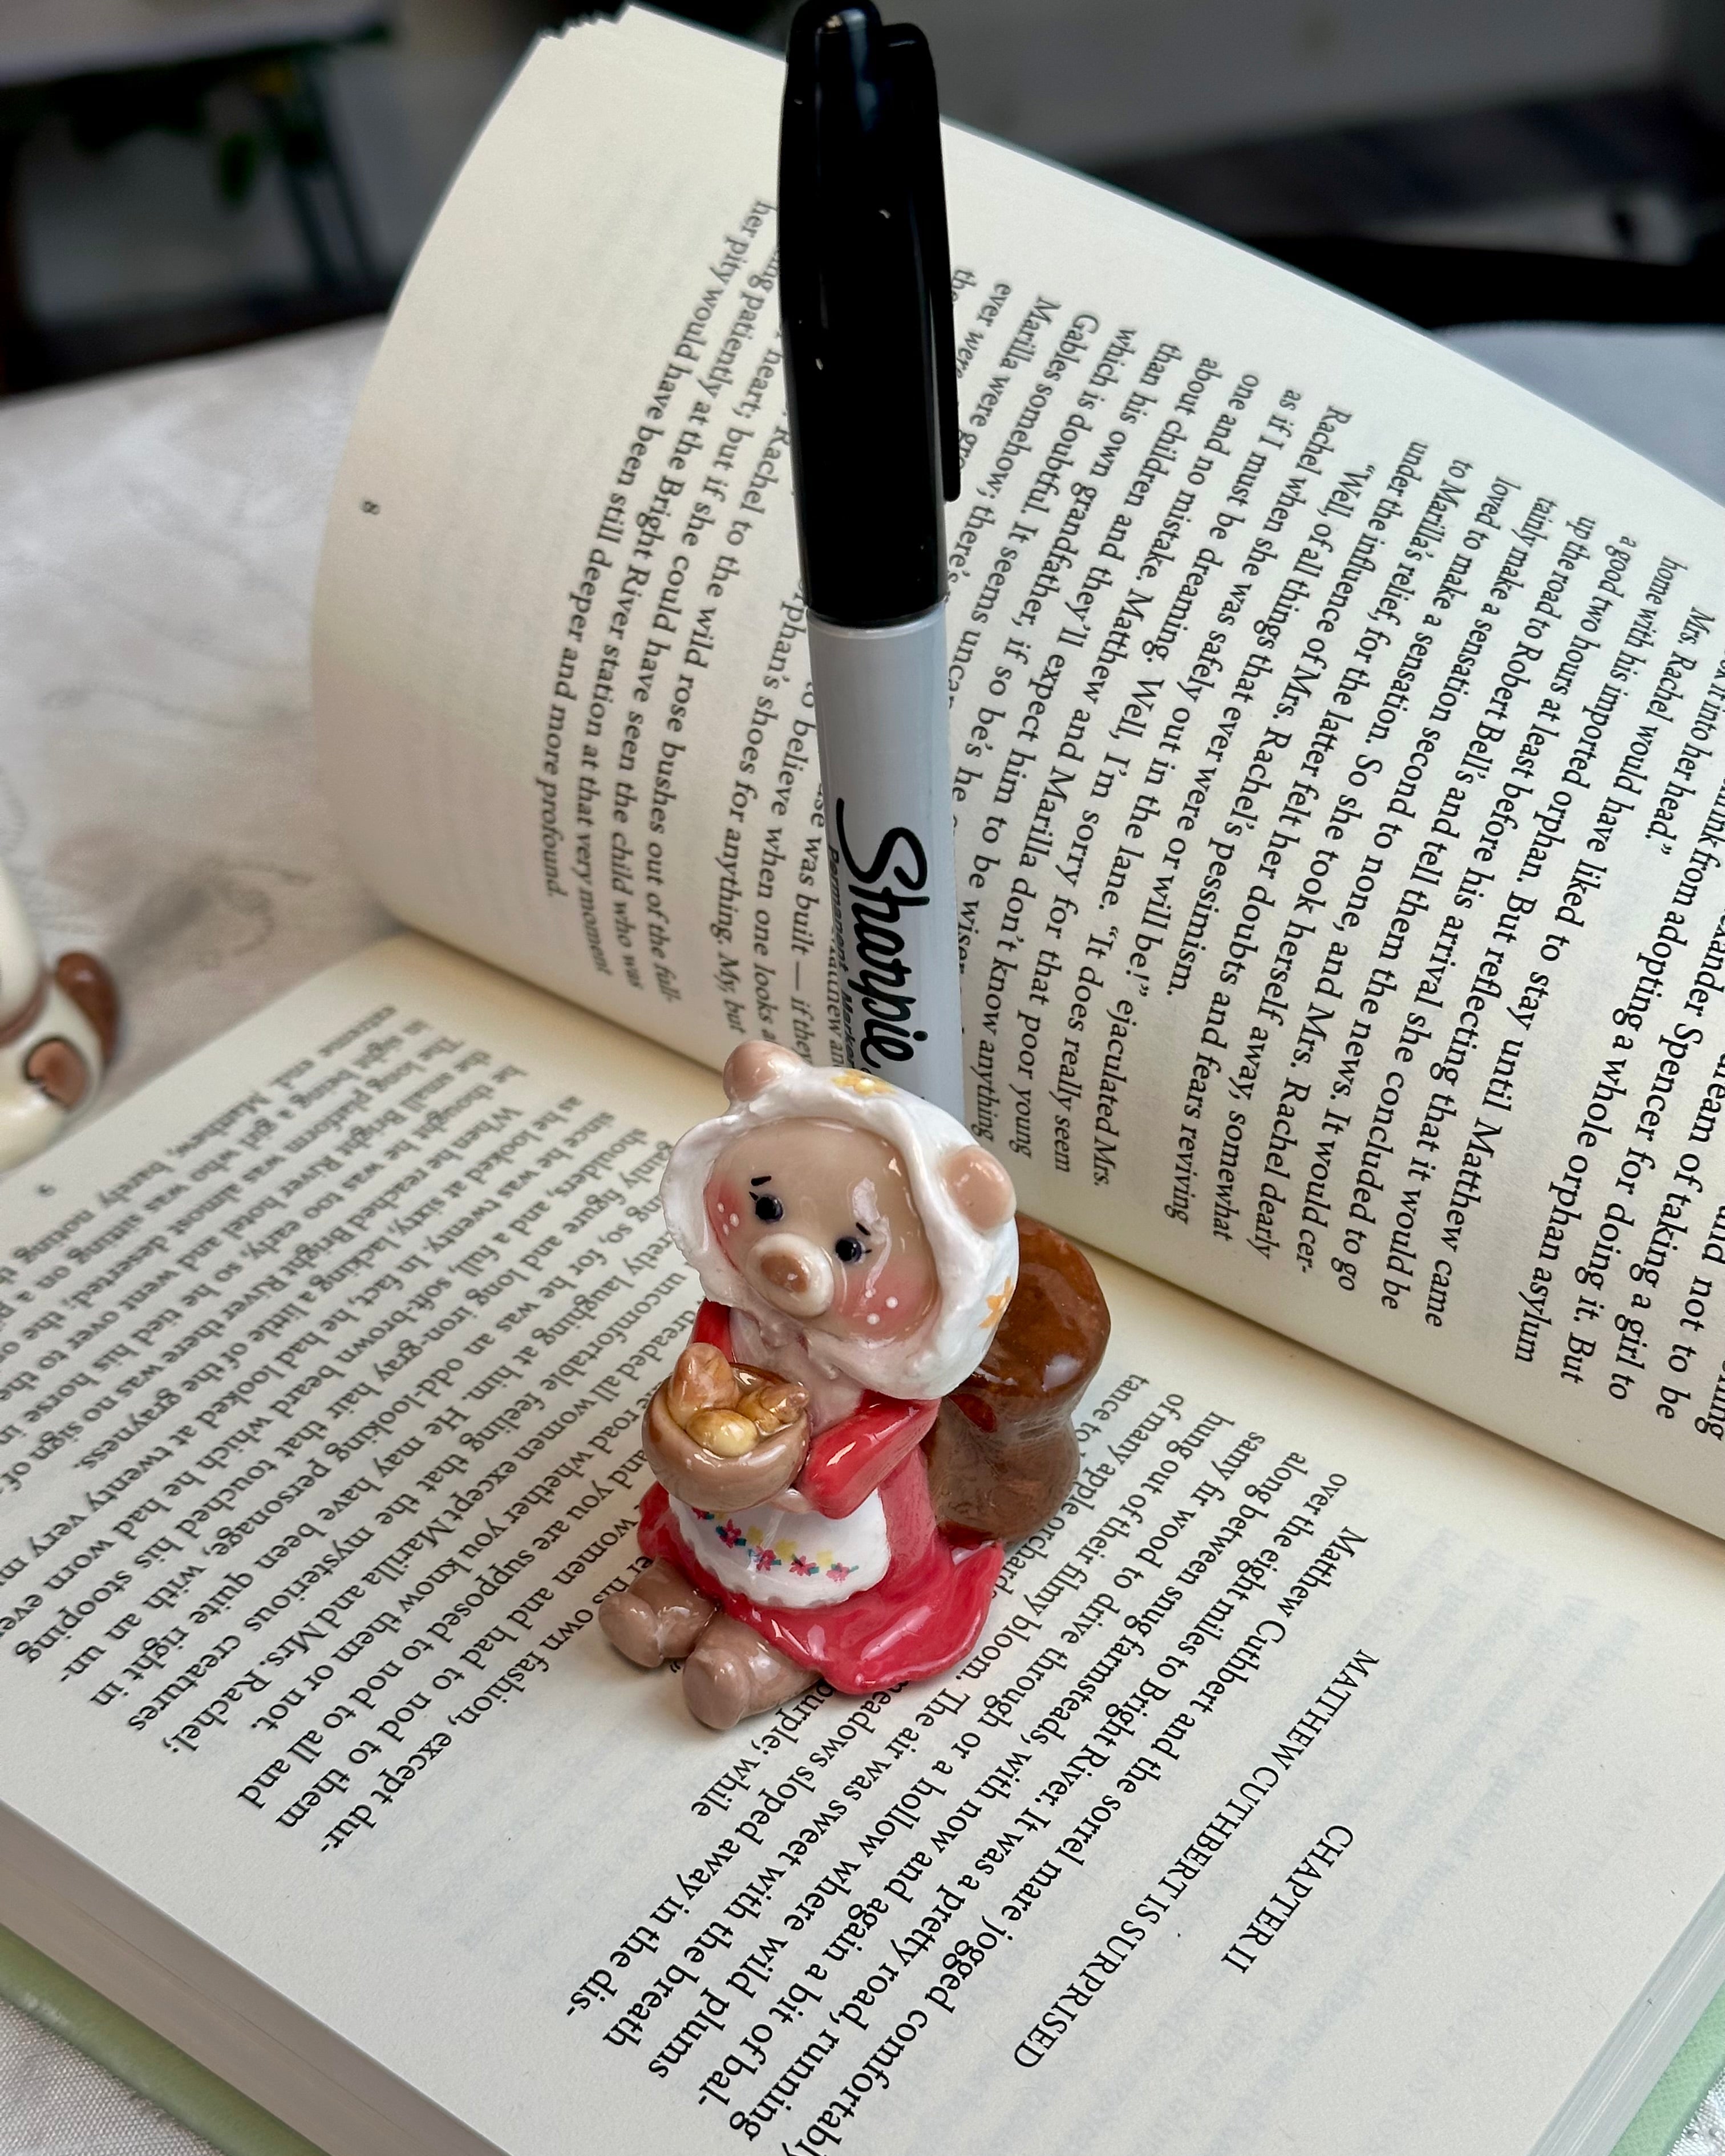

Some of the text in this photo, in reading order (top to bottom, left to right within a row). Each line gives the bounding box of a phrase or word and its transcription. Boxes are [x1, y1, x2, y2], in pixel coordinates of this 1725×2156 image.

[534, 200, 773, 897] her pity would have been still deeper and more profound.
[646, 425, 788, 1001] Rachel to the wild rose bushes out of the full-
[1008, 388, 1302, 1159] as if I must be dreaming. Well, I’m sorry for that poor young
[1093, 464, 1376, 1186] “Well, of all things that ever were or will be!” ejaculated Mrs.
[791, 892, 820, 955] built
[798, 837, 823, 887] was
[828, 840, 856, 1069] Permanent Marker
[835, 797, 931, 1069] Sharpie
[1424, 606, 1716, 1328] Mrs. Rachel would have liked to stay until Matthew came
[1611, 910, 1688, 1032] adopting
[1671, 847, 1722, 907] from
[790, 996, 815, 1022] if
[791, 1018, 816, 1066] they
[1576, 1059, 1628, 1148] whole
[1611, 1034, 1634, 1051] a
[0, 1107, 523, 1493] When he reached Bright River there was no sign of
[1514, 1266, 1553, 1363] asylum
[1537, 1154, 1589, 1261] orphan
[13, 1141, 675, 1664] gainly figure and long iron-gray hair that touched his stooping
[236, 1449, 649, 1810] and you are supposed to nod to all and
[320, 1608, 594, 1853] own fashion, except dur-
[647, 1431, 1266, 2079] samy fir wood to drive through or a hollow where wild plums
[690, 1758, 761, 1817] while
[728, 1473, 1347, 2142] over the eight miles to Bright River. It was a pretty road, running
[781, 1526, 1368, 2156] Matthew Cuthbert and the sorrel mare jogged comfortabl
[1013, 1648, 1380, 2068] MATTHEW CUTHBERT IS SURPRISED
[566, 1765, 816, 2017] sloped away in the dis-
[1220, 1825, 1354, 1975] CHAPTER II
